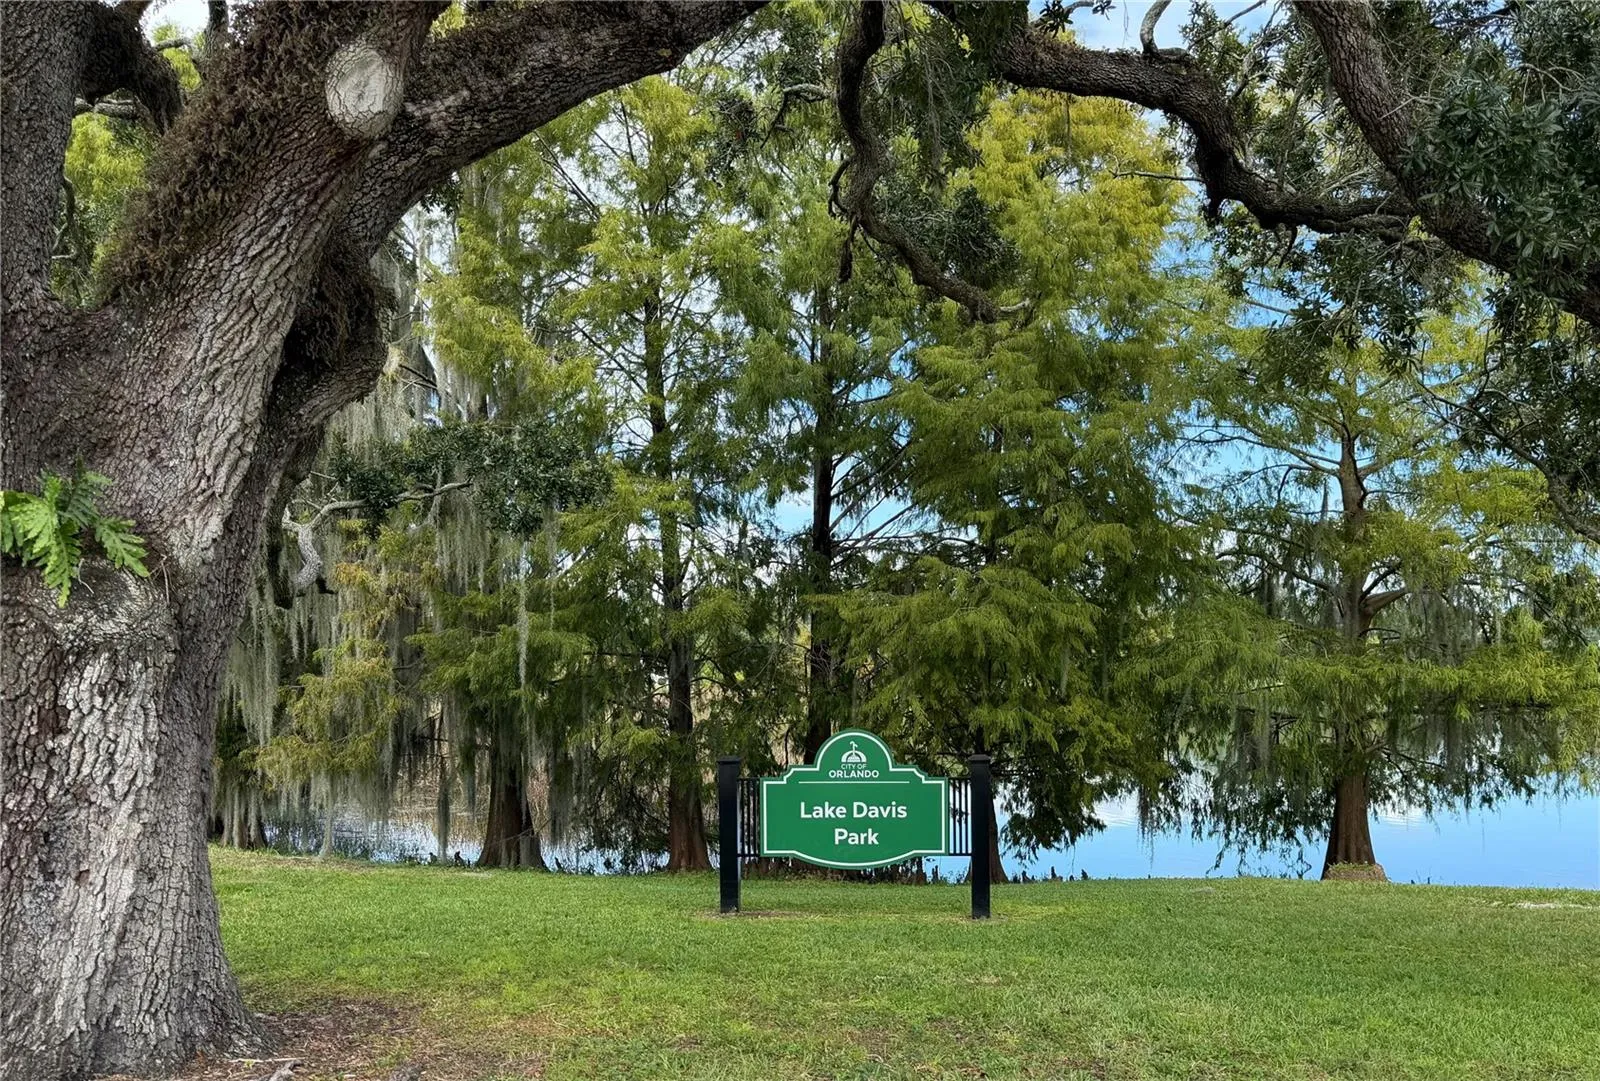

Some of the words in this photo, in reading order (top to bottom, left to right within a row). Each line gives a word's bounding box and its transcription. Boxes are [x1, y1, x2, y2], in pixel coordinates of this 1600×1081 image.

[828, 769, 880, 779] ORLANDO
[800, 801, 847, 819] Lake
[852, 801, 908, 819] Davis
[834, 828, 879, 845] Park
